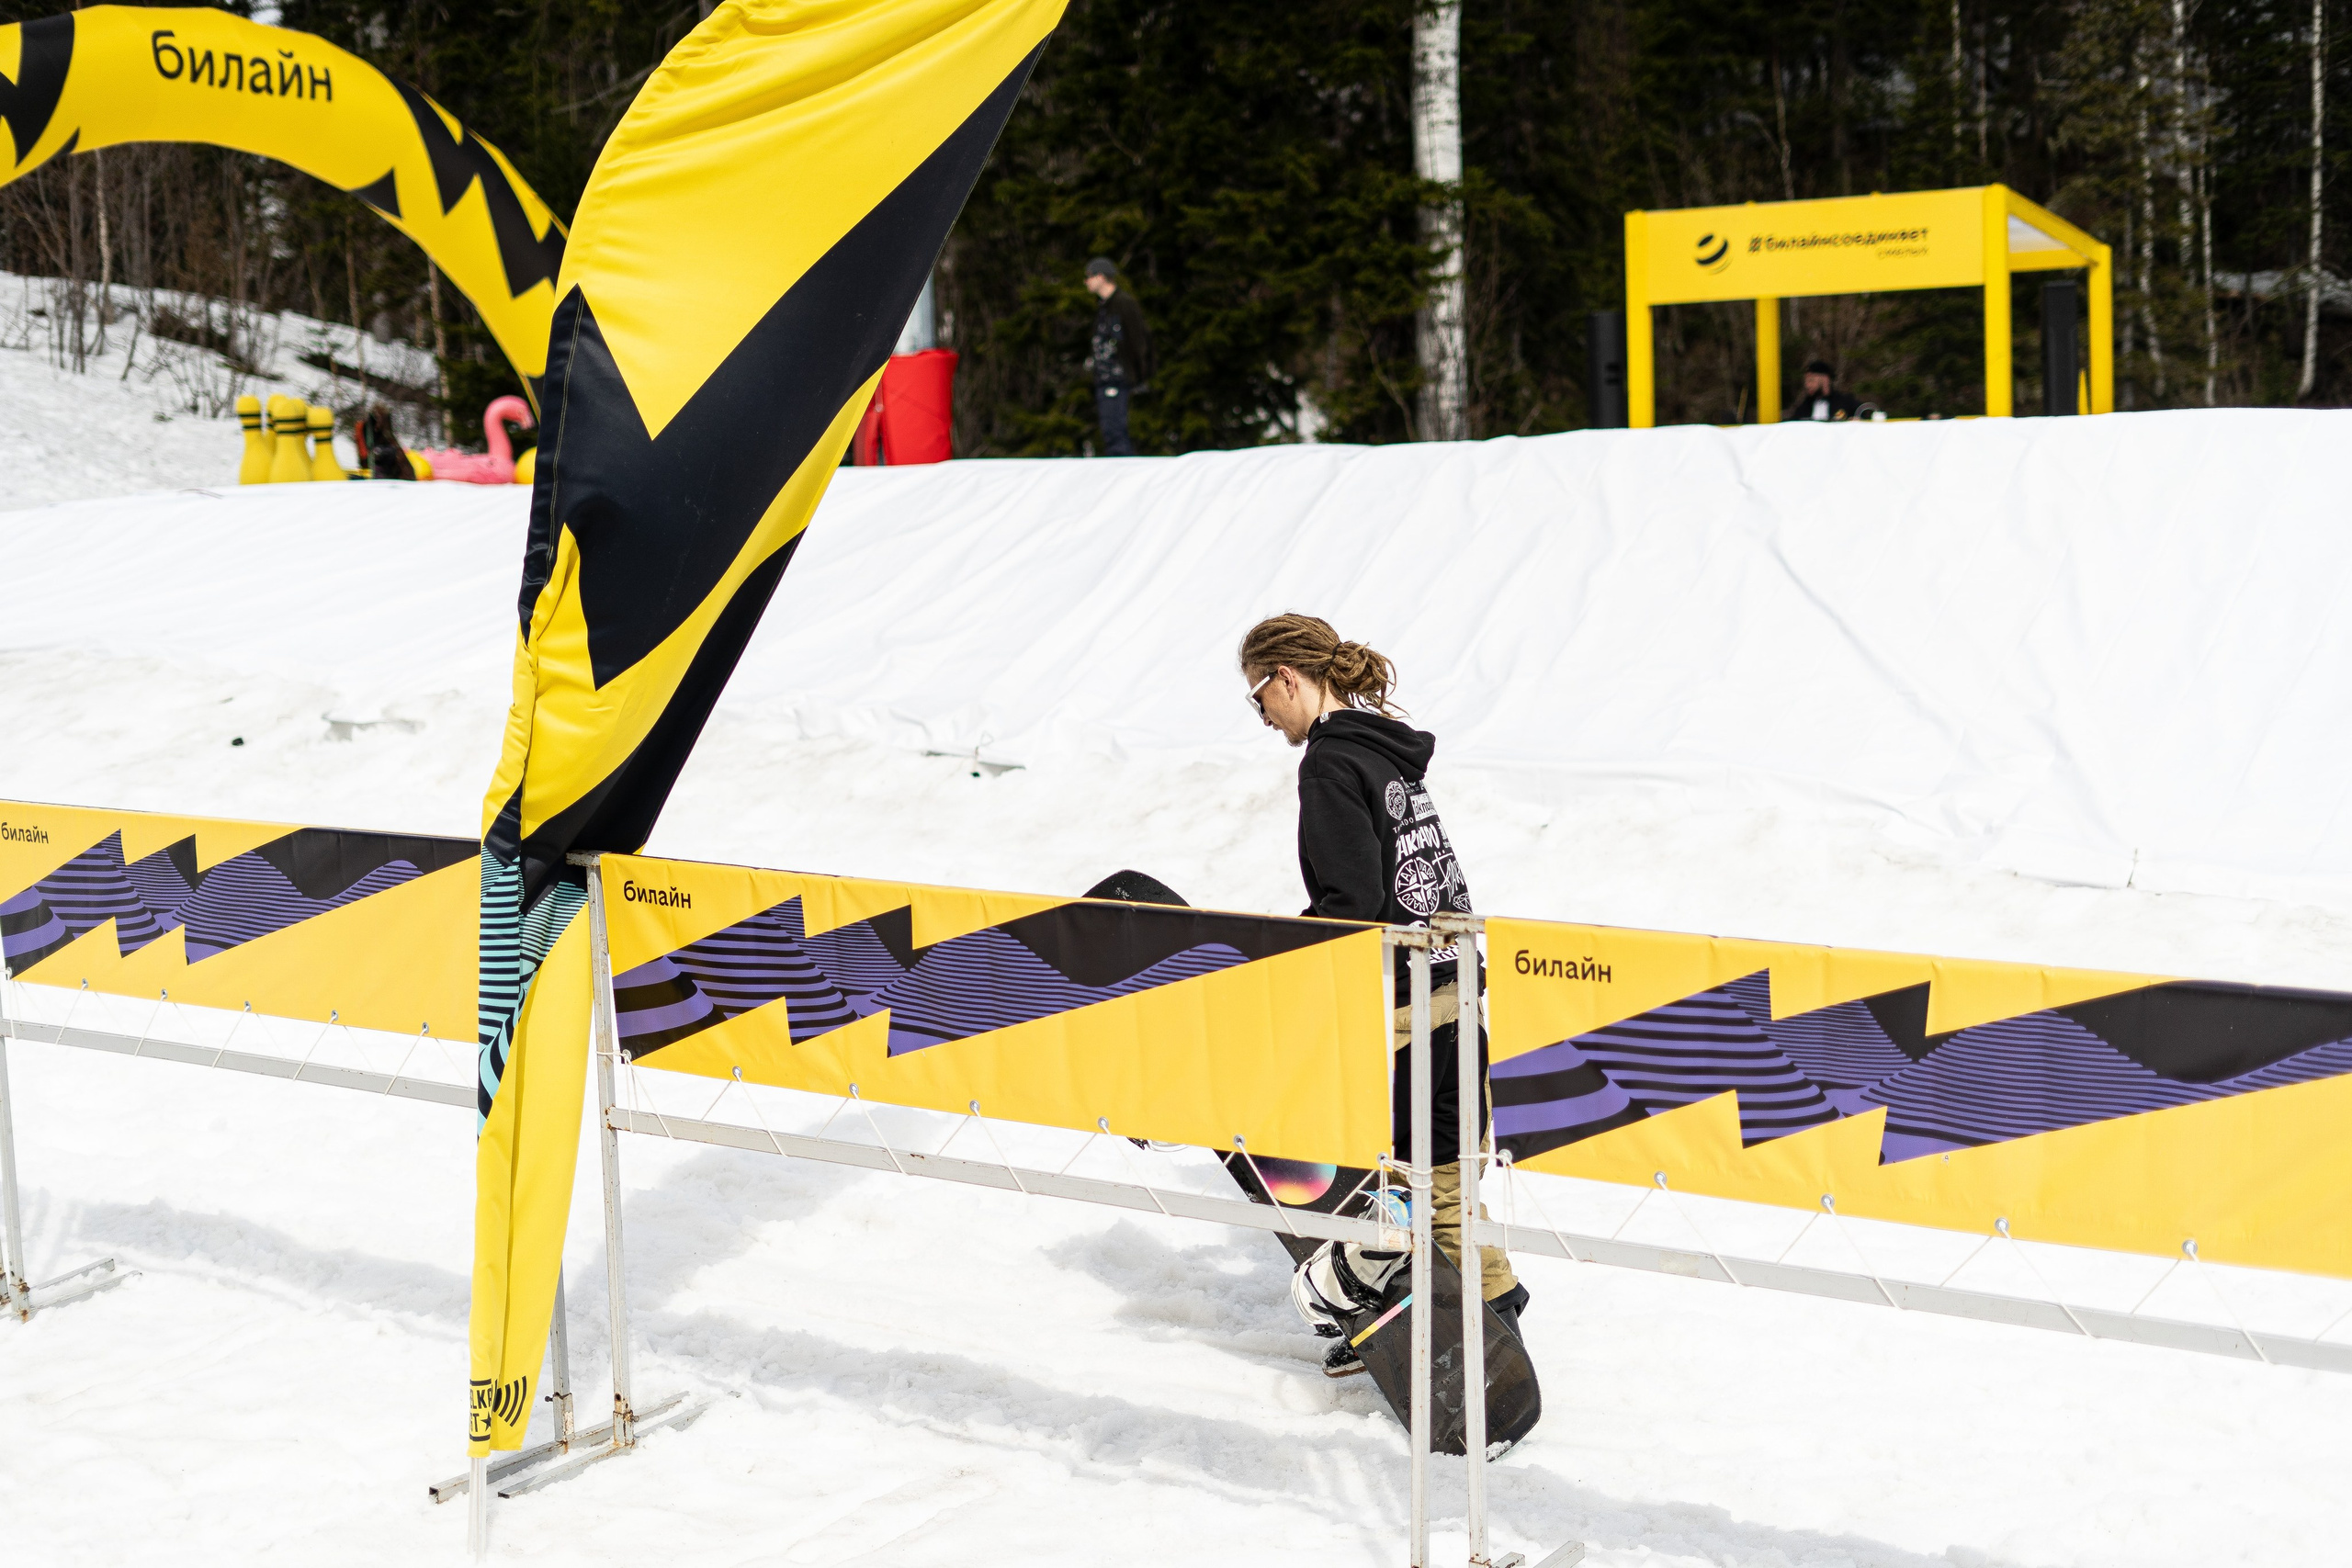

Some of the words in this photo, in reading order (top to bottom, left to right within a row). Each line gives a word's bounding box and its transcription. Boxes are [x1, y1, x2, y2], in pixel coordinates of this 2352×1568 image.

[152, 29, 333, 102] билайн
[1, 821, 49, 844] билайн
[624, 879, 692, 909] билайн
[1515, 949, 1611, 984] билайн
